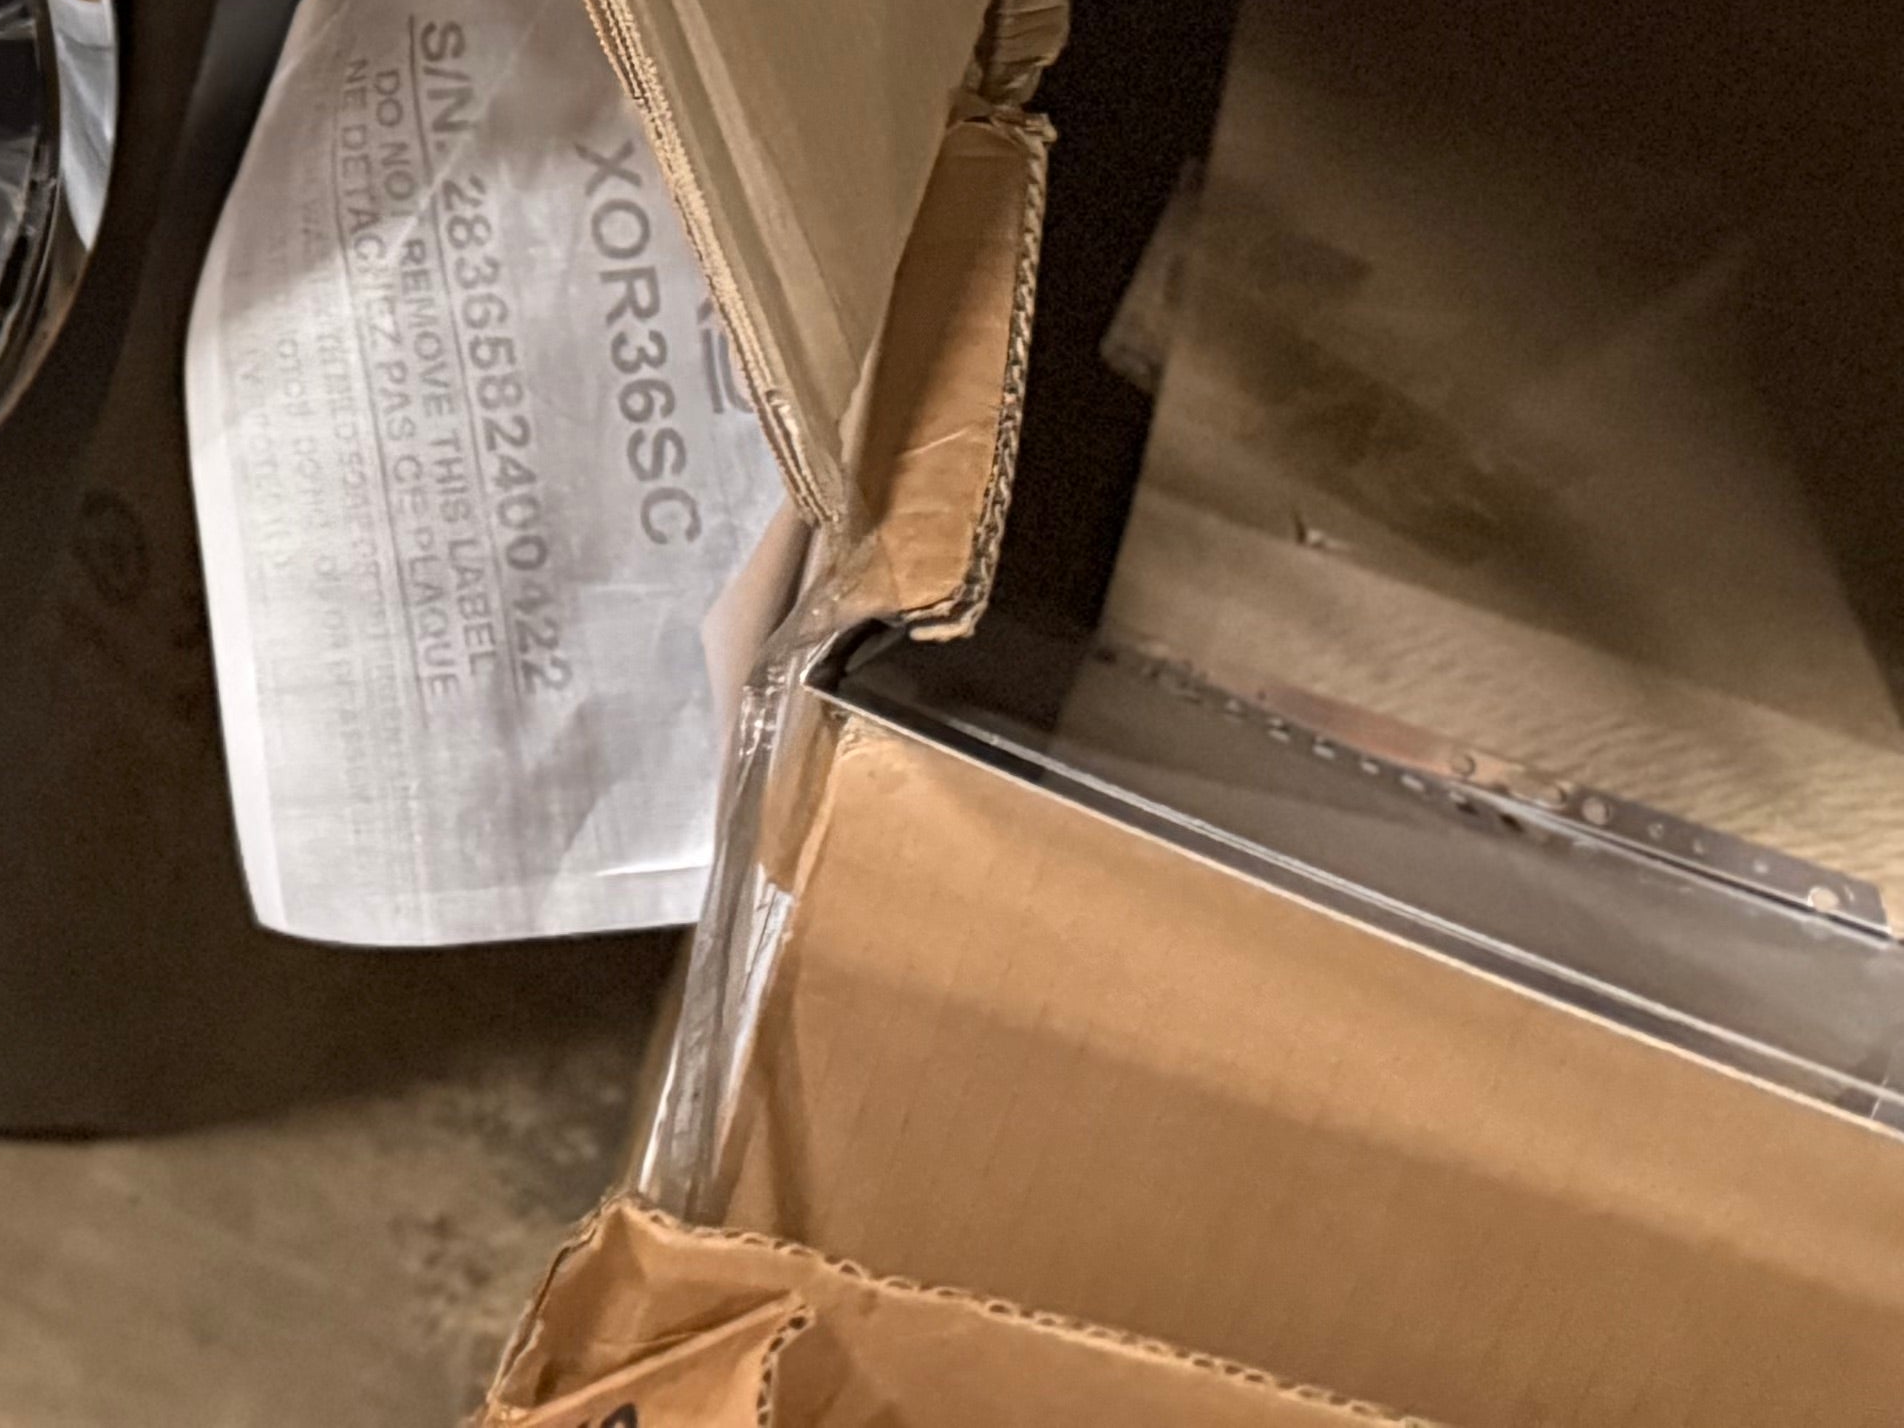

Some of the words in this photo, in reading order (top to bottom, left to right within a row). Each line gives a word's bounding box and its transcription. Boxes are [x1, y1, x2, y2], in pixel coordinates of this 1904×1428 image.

[374, 69, 404, 128] DO
[344, 58, 369, 111] NE
[375, 360, 417, 441] PAS
[408, 527, 458, 695] PLAQUE
[399, 238, 458, 418] REMOVE
[575, 140, 702, 546] XOR36SC
[430, 429, 473, 523] THIS
[449, 539, 496, 676] LABEL
